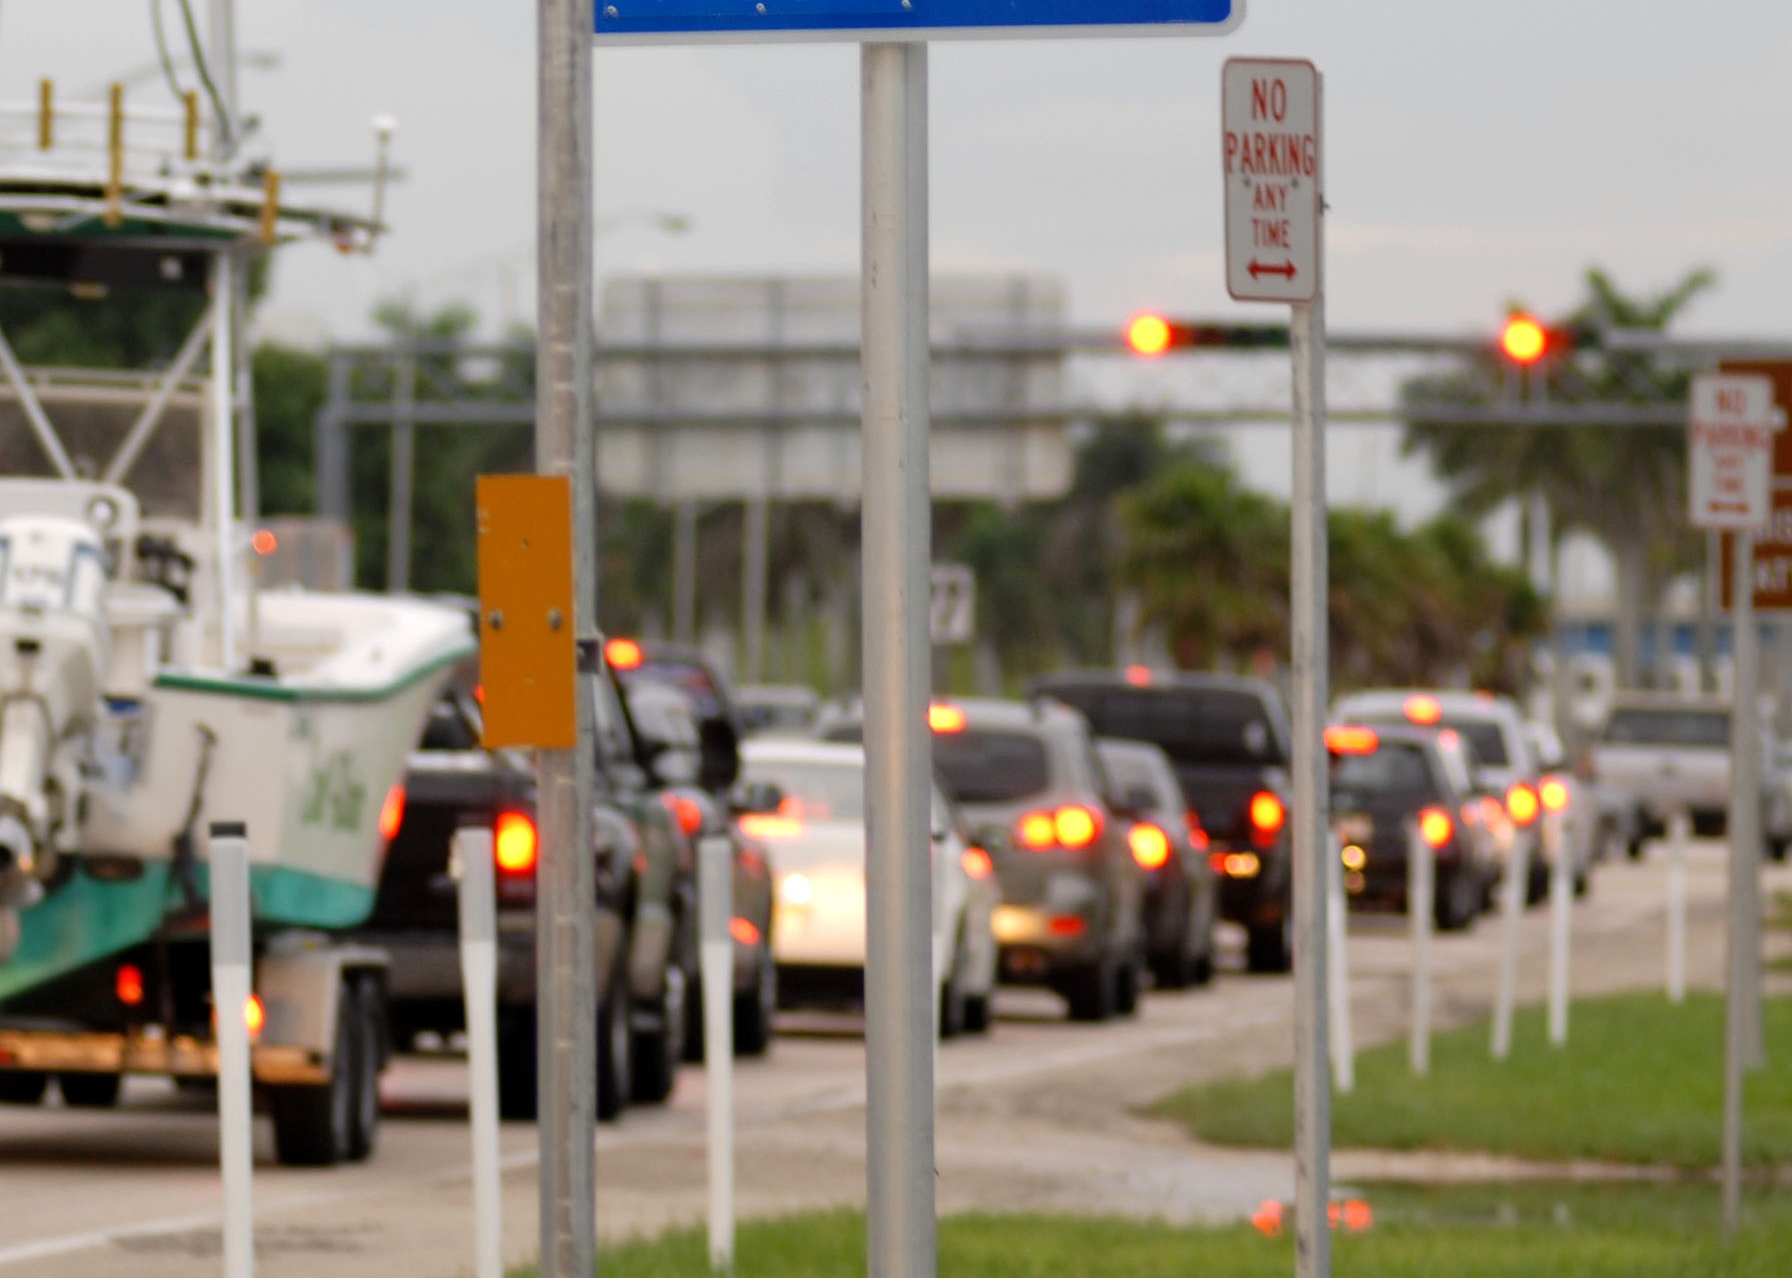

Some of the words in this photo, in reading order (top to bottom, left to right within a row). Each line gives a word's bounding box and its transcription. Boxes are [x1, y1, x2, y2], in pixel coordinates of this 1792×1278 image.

[1250, 77, 1287, 122] NO
[1225, 131, 1316, 177] PARKING
[1252, 182, 1288, 212] ANY
[1251, 217, 1292, 250] TIME
